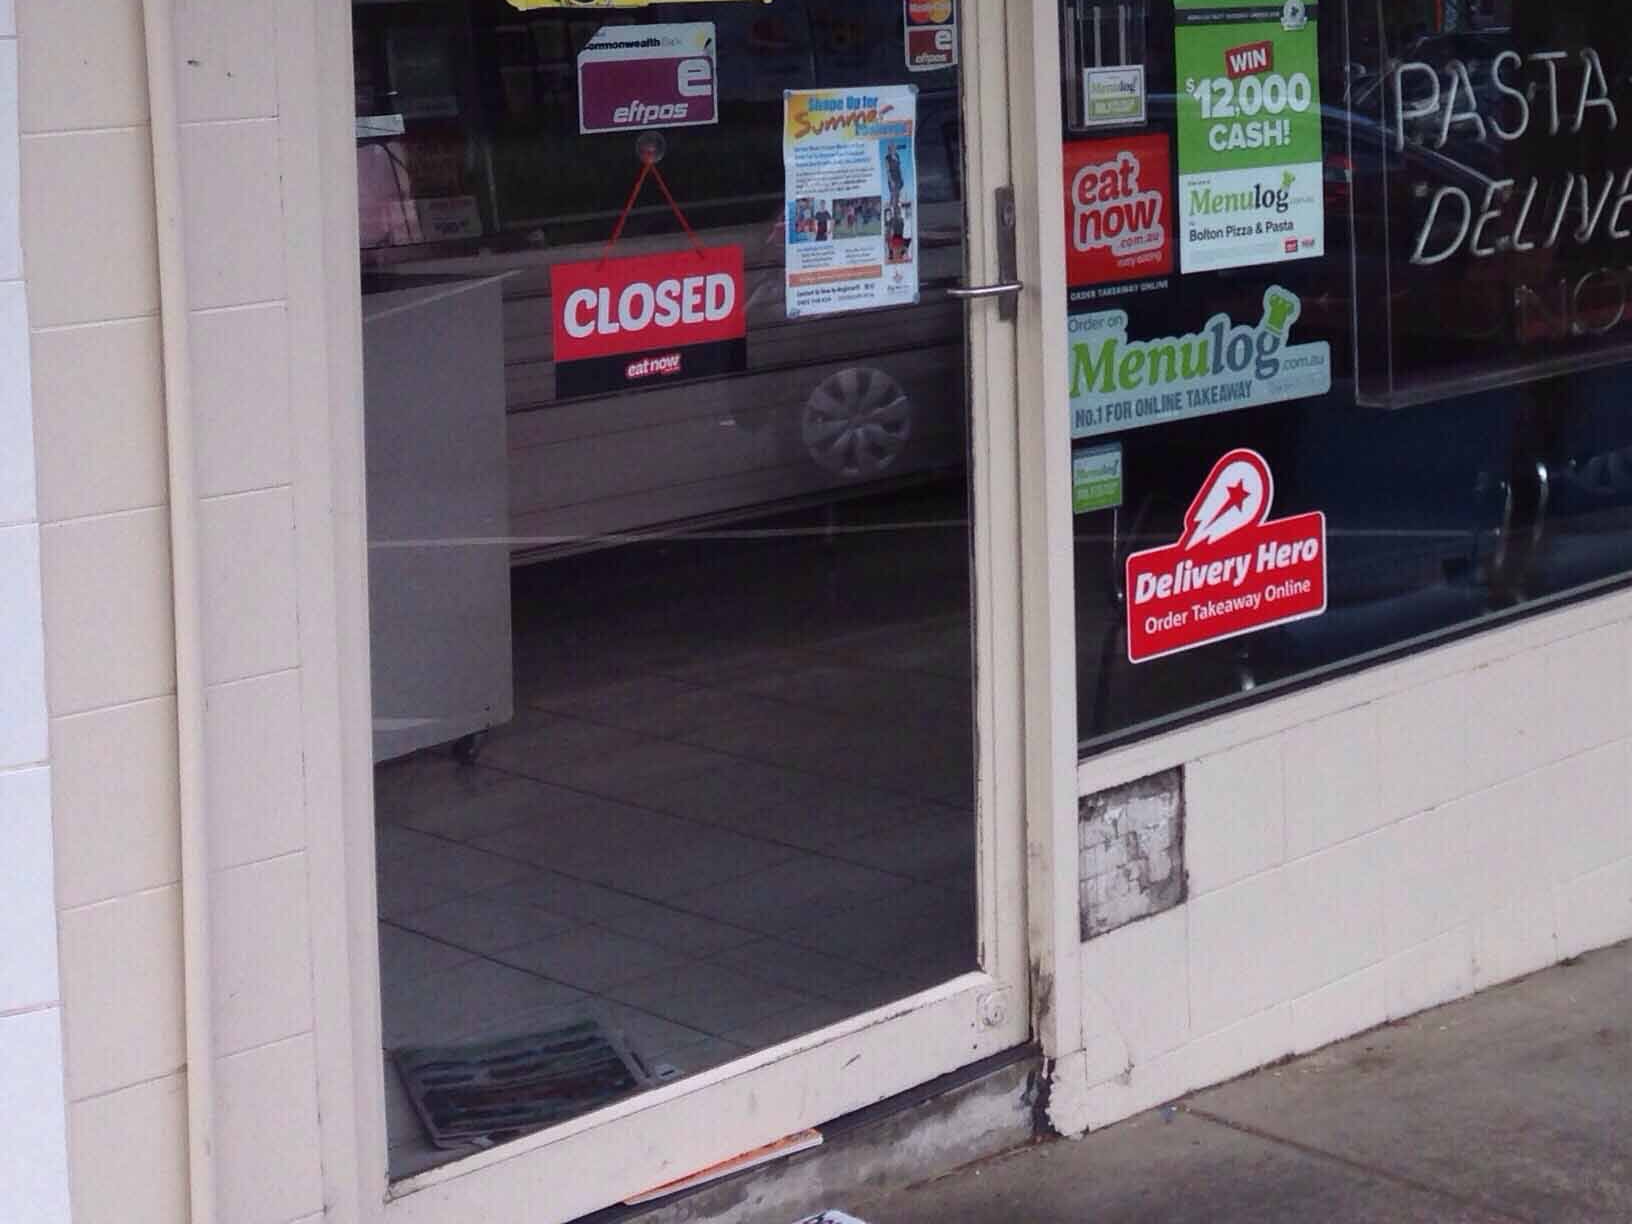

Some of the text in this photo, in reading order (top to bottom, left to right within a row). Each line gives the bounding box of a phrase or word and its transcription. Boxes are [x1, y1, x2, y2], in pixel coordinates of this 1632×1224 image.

[1229, 47, 1268, 73] WIN
[613, 99, 689, 125] eftpos
[1185, 72, 1312, 119] $12,000
[1395, 47, 1619, 152] PASTA
[794, 103, 895, 140] Summer
[1208, 119, 1291, 151] CASH!
[1078, 159, 1135, 205] eat
[1188, 182, 1290, 217] Menulog
[1080, 199, 1158, 244] now
[1188, 218, 1295, 243] Bolton Pizza & Pasta
[563, 272, 736, 339] CLOSED
[1068, 314, 1124, 334] Order on
[628, 355, 682, 377] eat now
[1105, 402, 1133, 424] FOR
[1135, 393, 1183, 418] ONLINE
[1186, 380, 1253, 409] TAKEAWAY
[1135, 537, 1320, 605] Delivery Hero
[1144, 577, 1311, 635] Order Takeaway Online
